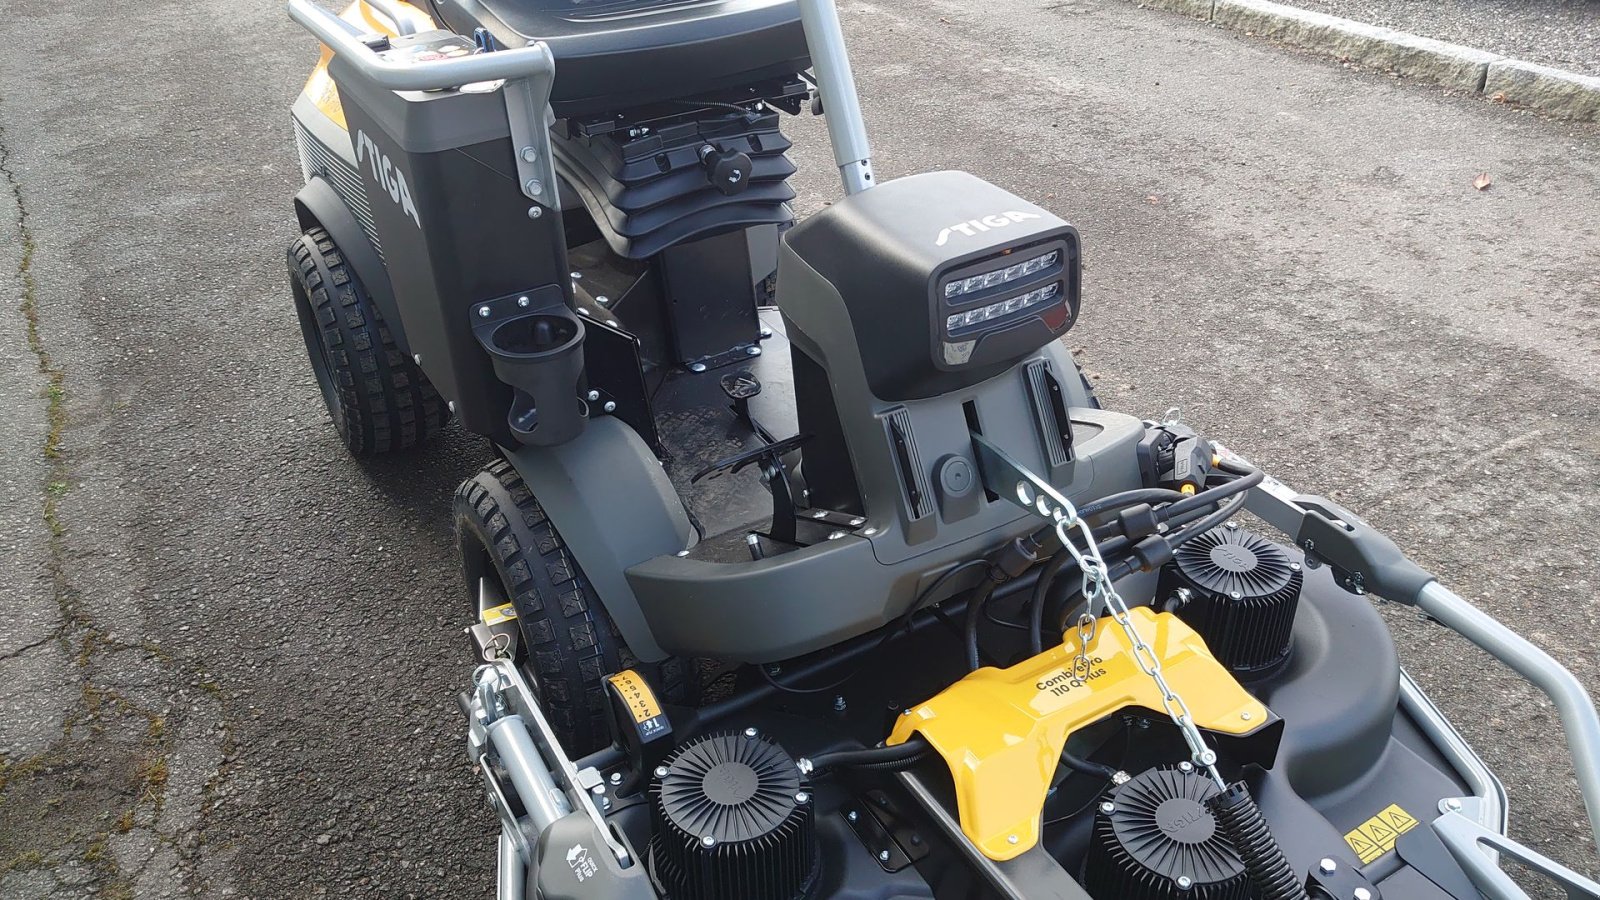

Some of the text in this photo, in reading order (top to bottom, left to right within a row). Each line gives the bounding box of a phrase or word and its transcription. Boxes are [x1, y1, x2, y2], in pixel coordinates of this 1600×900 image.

[357, 130, 421, 229] STIGA
[935, 211, 1041, 247] STIGA
[1050, 684, 1070, 696] 110
[1070, 679, 1083, 688] Q
[639, 700, 646, 708] 3
[643, 709, 651, 717] 2
[581, 861, 593, 877] FLIP
